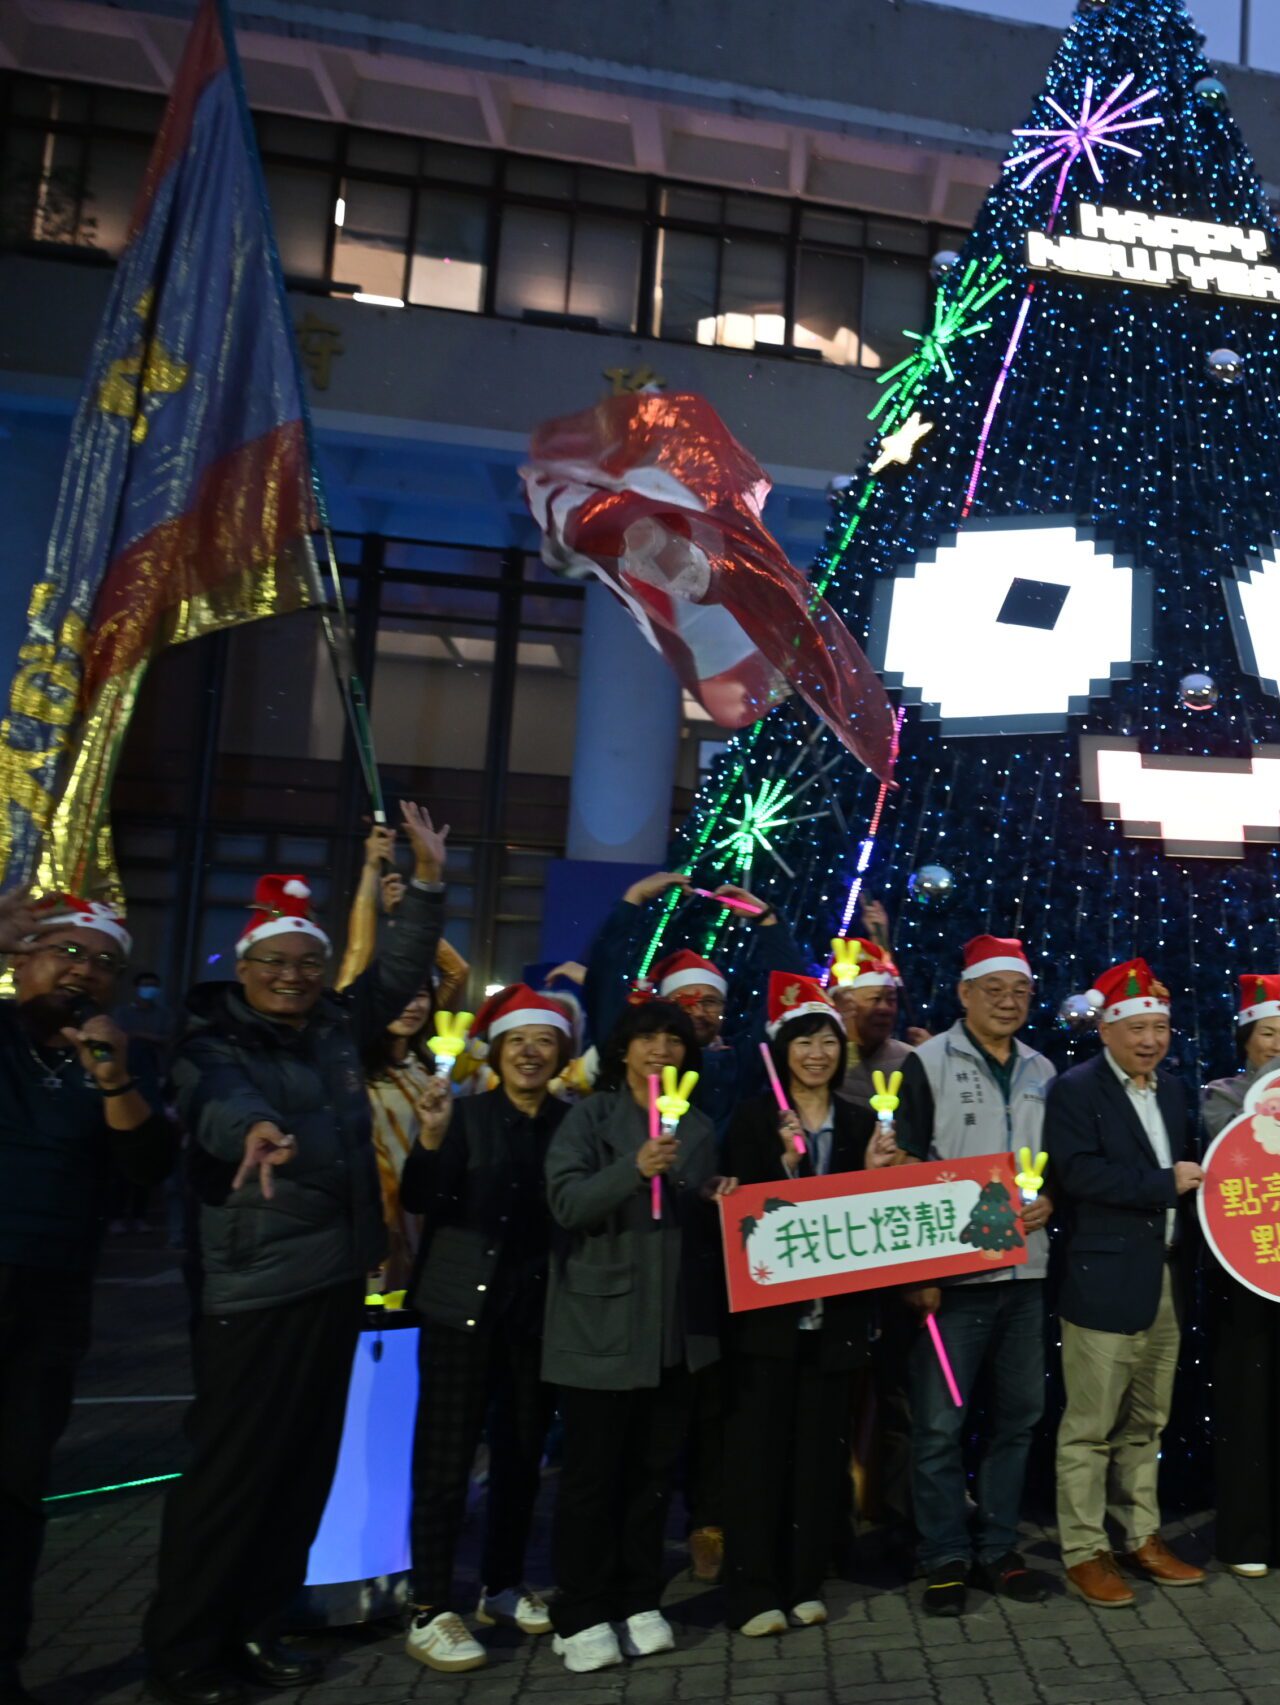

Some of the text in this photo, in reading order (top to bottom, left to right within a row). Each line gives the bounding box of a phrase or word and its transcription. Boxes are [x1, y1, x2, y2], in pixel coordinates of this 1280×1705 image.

[1027, 231, 1174, 284] NEW
[1079, 202, 1267, 262] HAPPY
[775, 1199, 958, 1268] 我比燈靚
